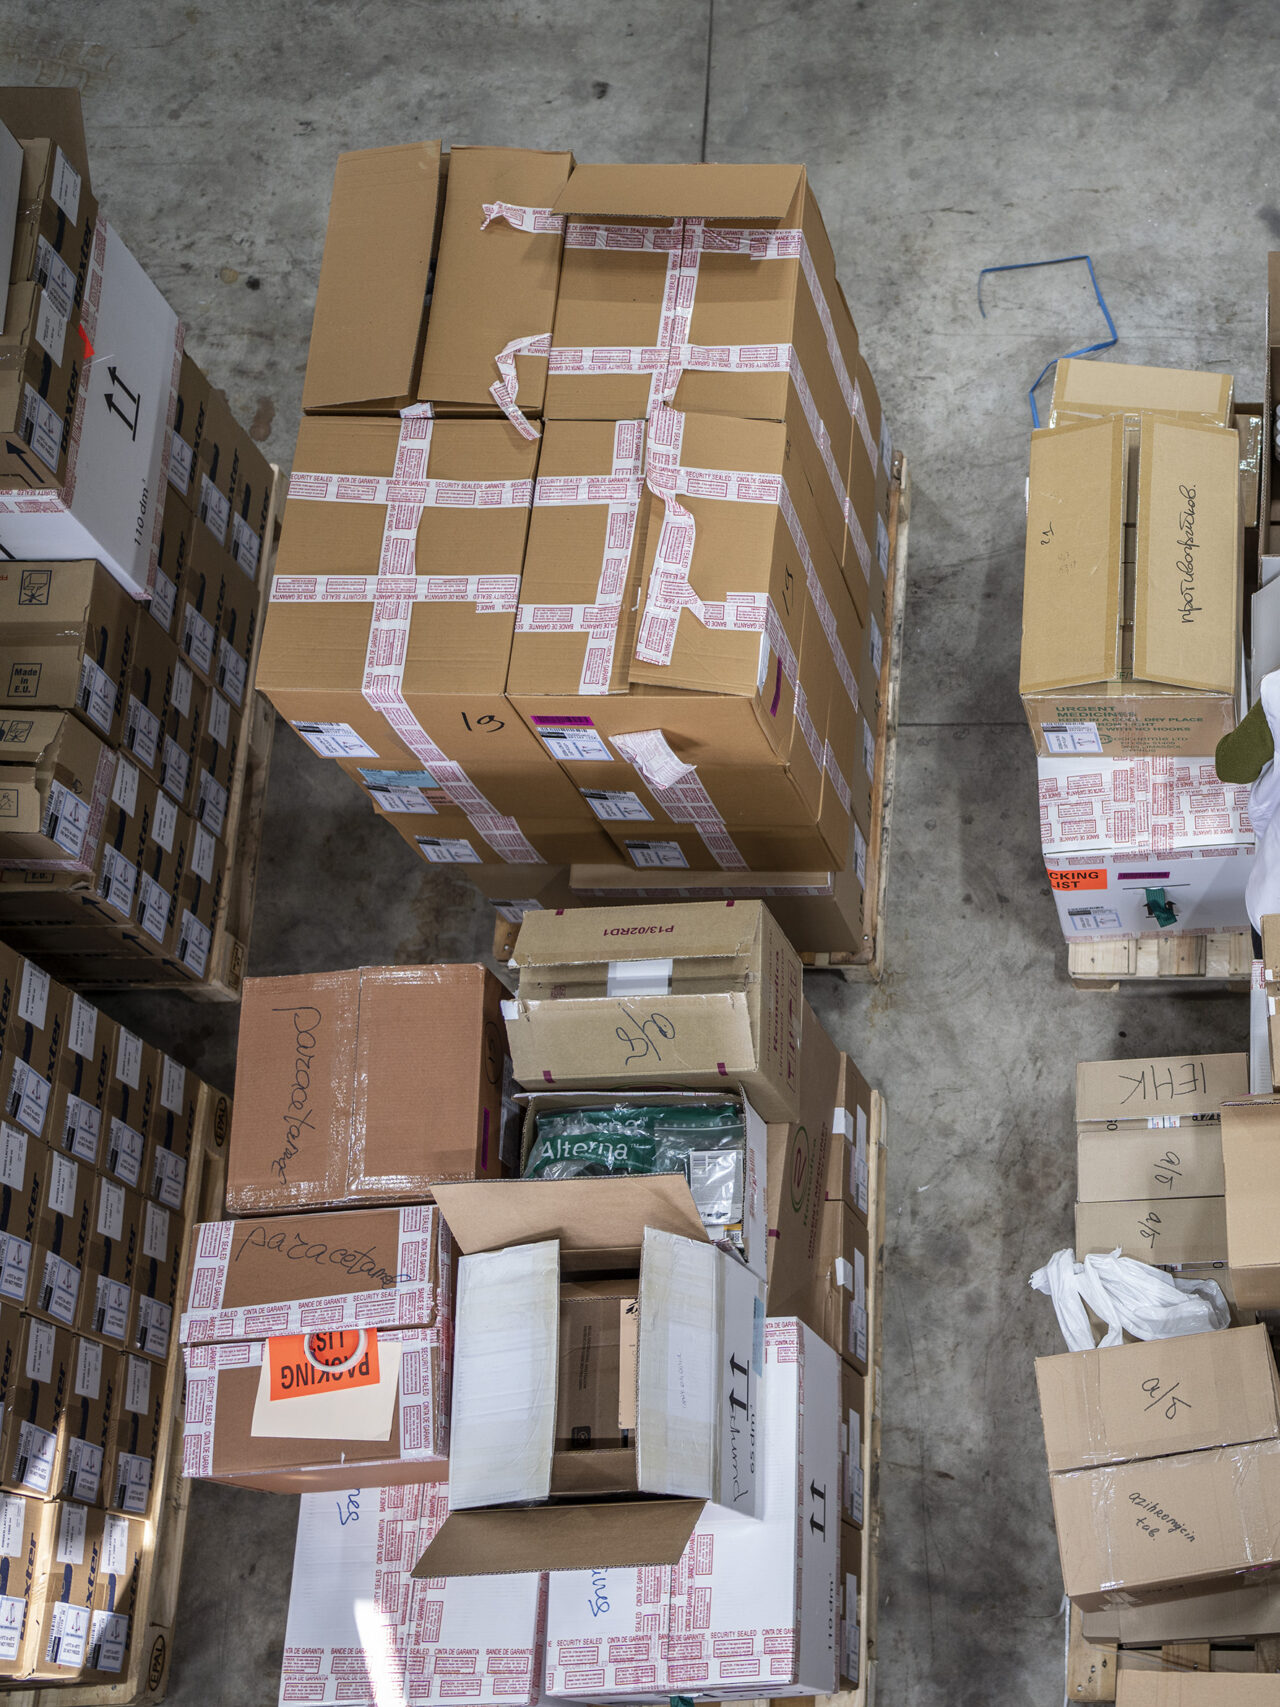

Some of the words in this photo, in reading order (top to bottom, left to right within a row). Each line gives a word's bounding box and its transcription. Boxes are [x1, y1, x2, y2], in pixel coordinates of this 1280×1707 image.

[290, 473, 311, 481] ECURITY
[686, 471, 709, 480] SECURITY
[710, 473, 732, 482] SEALED
[134, 519, 144, 545] 110
[15, 667, 38, 676] Made
[14, 685, 31, 693] E.U.
[1050, 872, 1099, 880] CKING
[604, 925, 675, 936] P13/02RD1
[540, 1139, 628, 1160] Alterna
[323, 1297, 348, 1306] GARANTIE
[353, 1293, 379, 1301] SECURITY
[267, 1305, 291, 1313] GARANTIA
[207, 1376, 215, 1402] SECURITY
[204, 1404, 213, 1426] SEALED
[151, 1642, 163, 1686] EPAL
